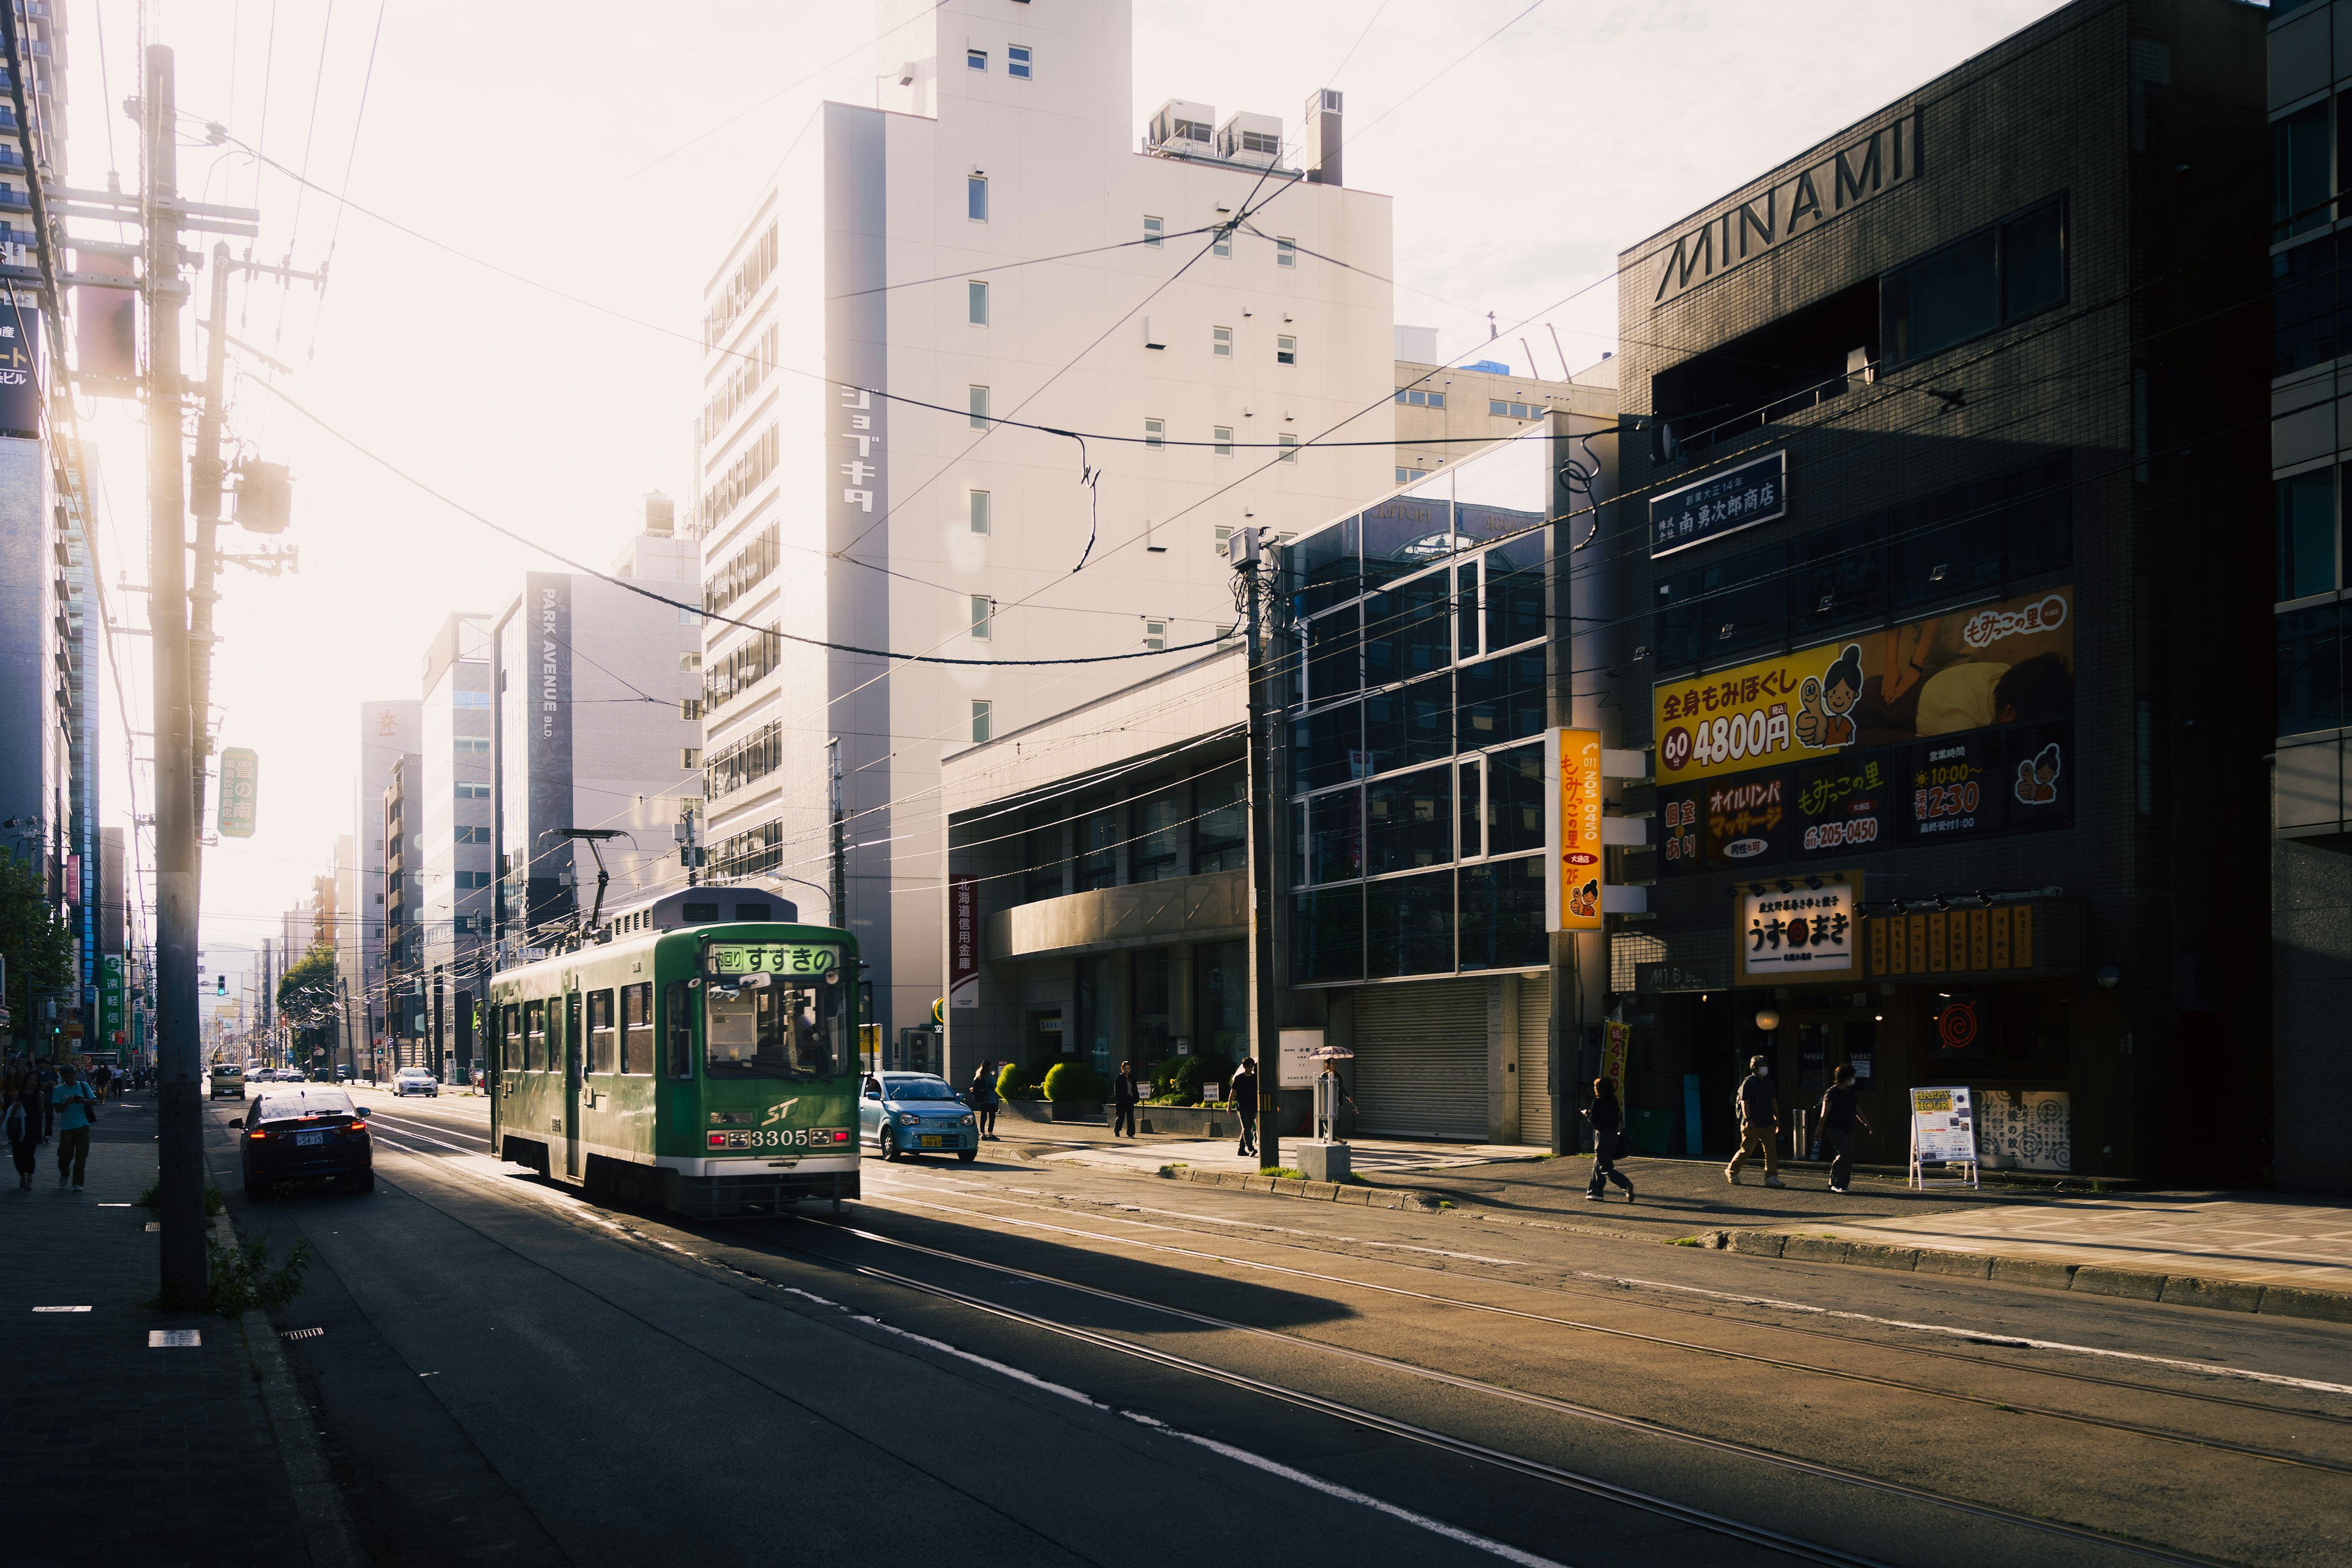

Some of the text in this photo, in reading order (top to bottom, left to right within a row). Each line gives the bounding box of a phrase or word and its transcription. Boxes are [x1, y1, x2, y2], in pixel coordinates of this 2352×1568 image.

[1654, 116, 1904, 303] MINAMI
[840, 385, 880, 513] ジョブキタ
[1686, 477, 1743, 506] 創業大正14年
[1679, 482, 1774, 534] 南勇次郎商店
[1967, 606, 2041, 644] もみっこの里
[543, 587, 557, 741] PARK AVENUE BLD.
[1662, 668, 1798, 723] 全身もみほぐし
[1665, 732, 1688, 759] 60
[1692, 709, 1790, 766] 4800円
[1929, 746, 1966, 762] 営業時間
[1561, 754, 1583, 849] もみっこの里
[1710, 778, 1782, 814] オイルリンパ
[1798, 761, 1885, 815] もみっこの里
[1929, 781, 1979, 818] 2:30
[1665, 800, 1695, 827] 個室
[1708, 805, 1783, 839] マッサージ
[1920, 818, 1974, 834] 最終受付1:00
[1665, 834, 1695, 860] あり
[1730, 840, 1761, 856] 男性も可
[1566, 869, 1579, 885] 2F
[1758, 896, 1839, 913] 炭火野菜巻き串と餃子
[958, 878, 971, 970] 北海道信用金庫
[746, 947, 835, 972] すすきの
[934, 1024, 943, 1033] 空
[1915, 1090, 1950, 1100] HAPPY
[1915, 1101, 1950, 1110] HOUR
[761, 1097, 799, 1126] ST
[752, 1130, 808, 1147] 3305
